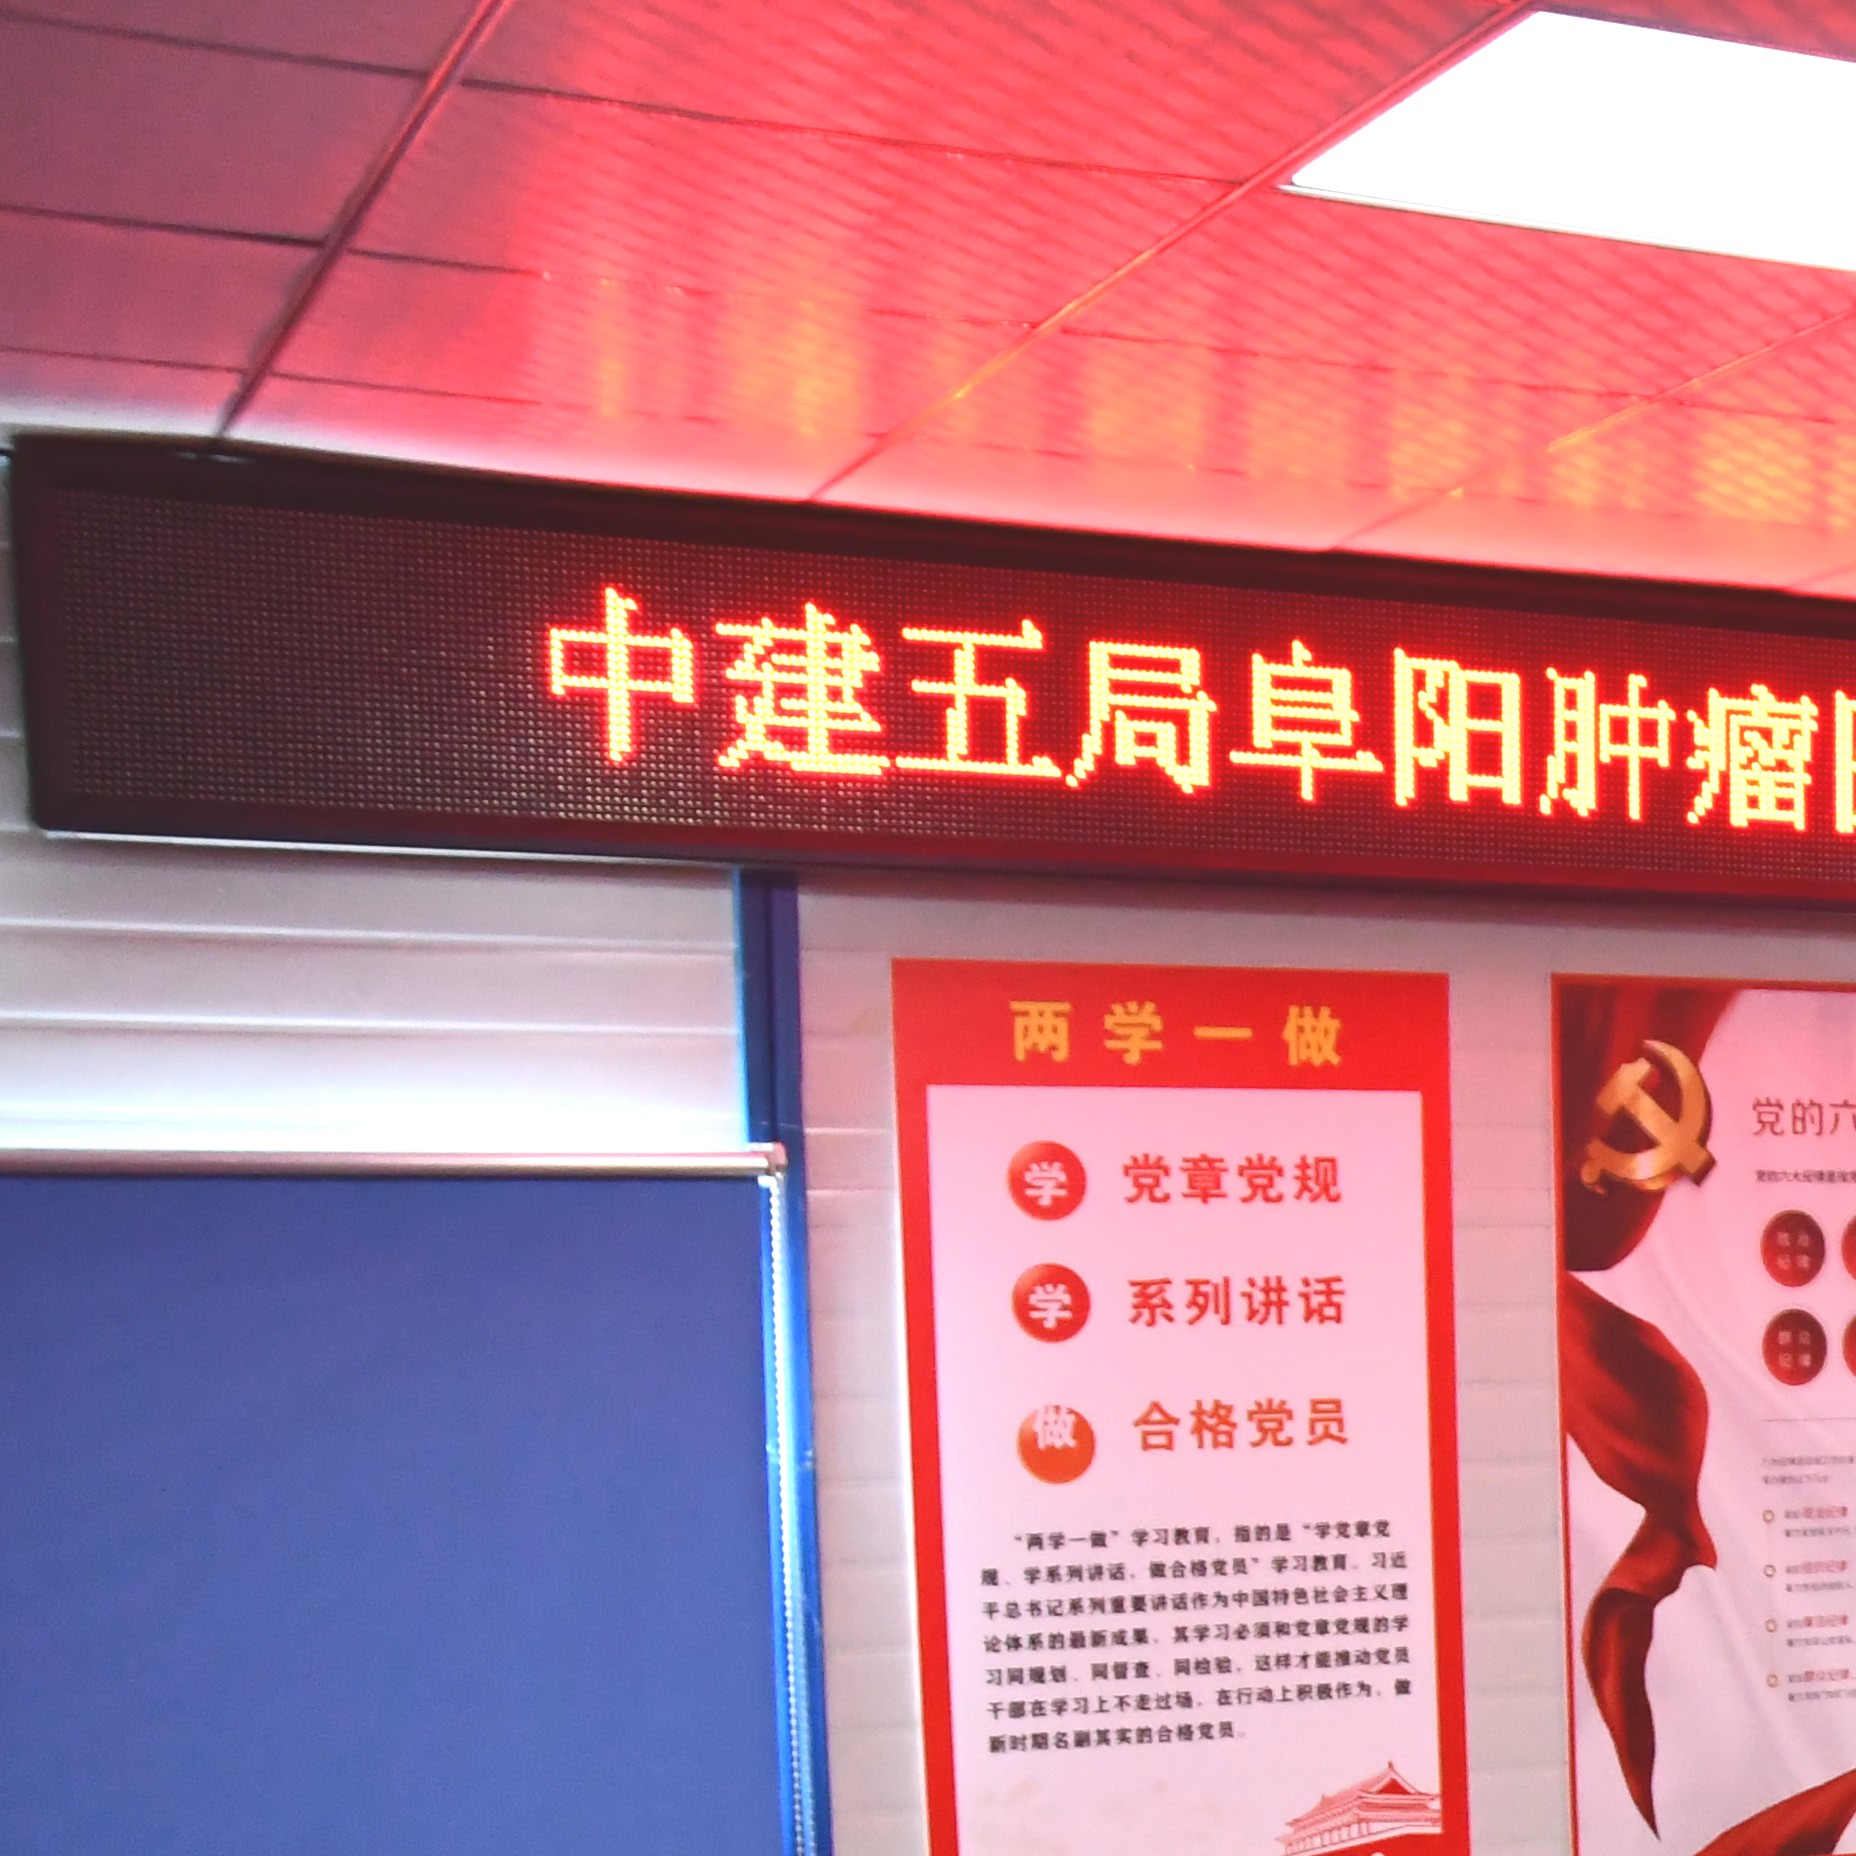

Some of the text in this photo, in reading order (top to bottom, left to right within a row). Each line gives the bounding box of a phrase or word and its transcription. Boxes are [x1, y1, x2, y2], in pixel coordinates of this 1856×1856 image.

[1009, 999, 1342, 1065] 两学一做
[1023, 1160, 1068, 1207] 学
[1122, 1153, 1343, 1204] 党章党规
[1027, 1282, 1074, 1330] 学
[1127, 1276, 1347, 1327] 系列讲话
[1032, 1403, 1078, 1449] 做
[1132, 1397, 1349, 1451] 合格党员
